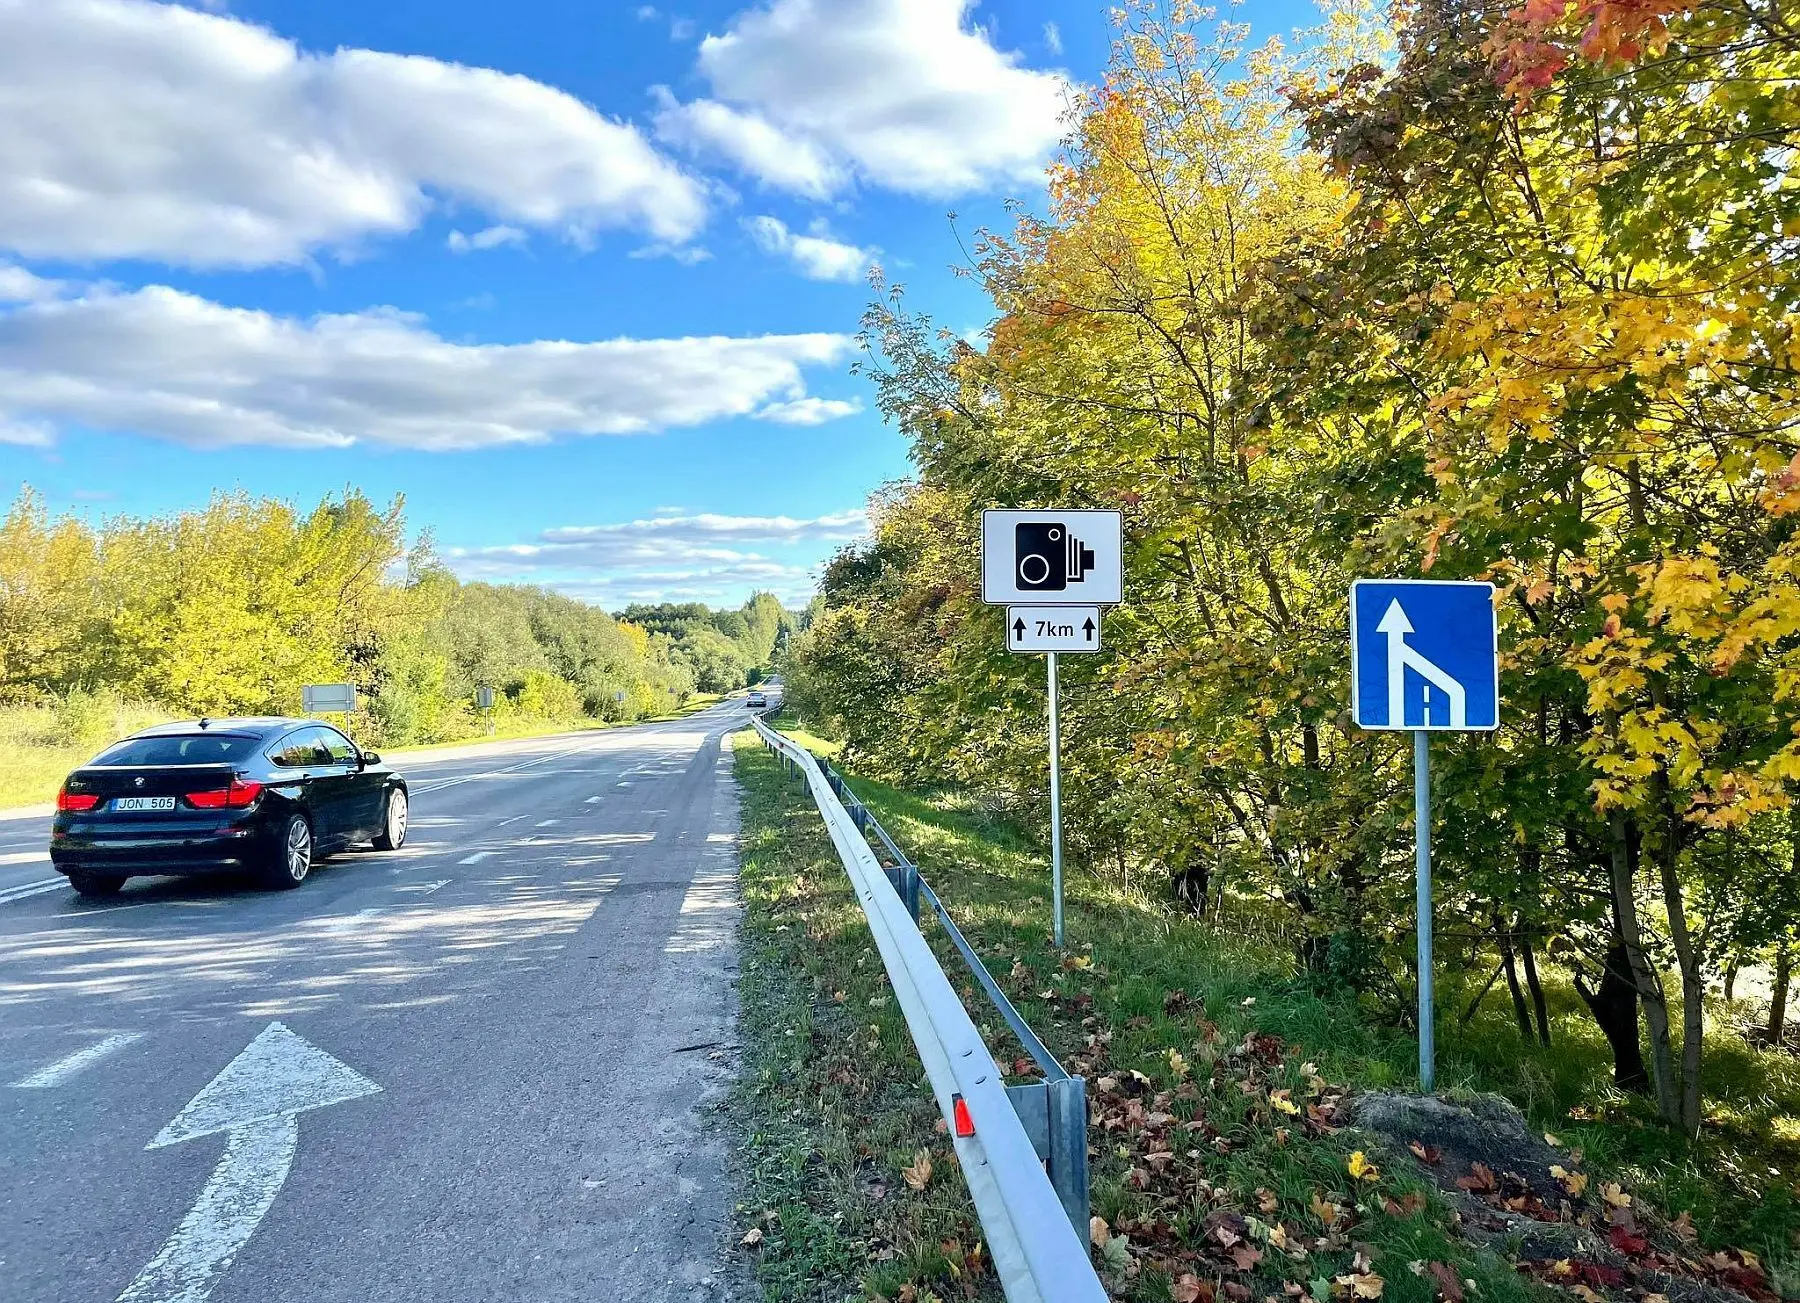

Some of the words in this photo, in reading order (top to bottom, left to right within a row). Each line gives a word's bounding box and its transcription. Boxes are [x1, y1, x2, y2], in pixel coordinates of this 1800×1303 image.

[1035, 621, 1074, 637] 7km
[119, 799, 144, 809] JON
[151, 798, 173, 808] 505
